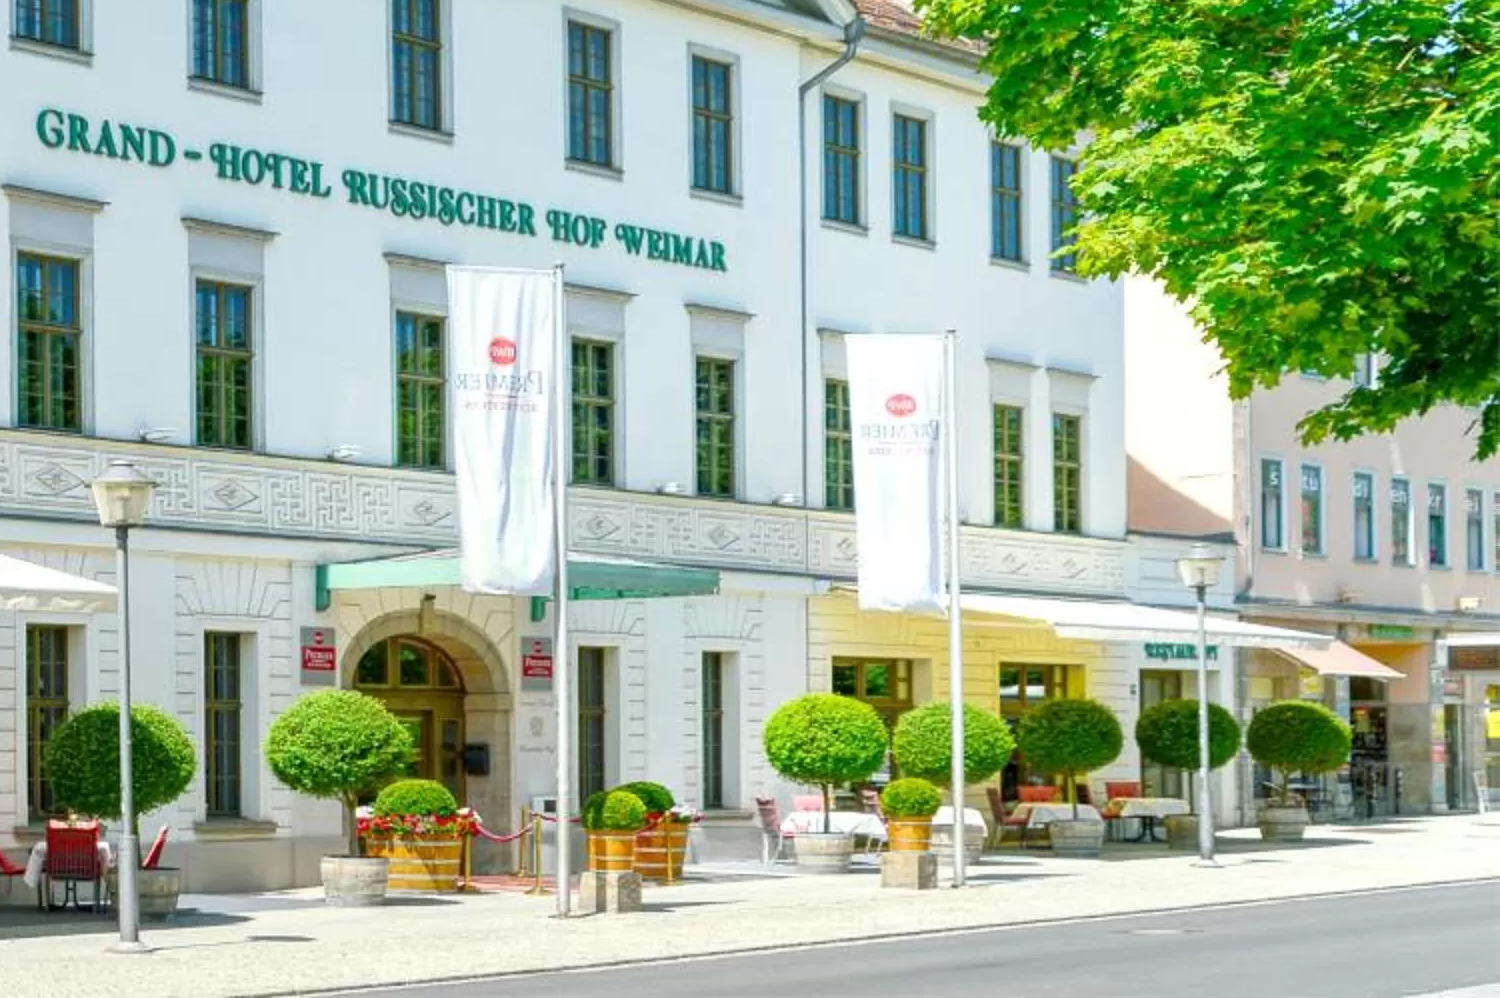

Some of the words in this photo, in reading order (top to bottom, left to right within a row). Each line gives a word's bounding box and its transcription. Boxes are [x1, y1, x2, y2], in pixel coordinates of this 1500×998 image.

[342, 167, 538, 236] RUSSISCHER
[547, 207, 607, 249] HOF
[615, 223, 729, 273] WEIMAR
